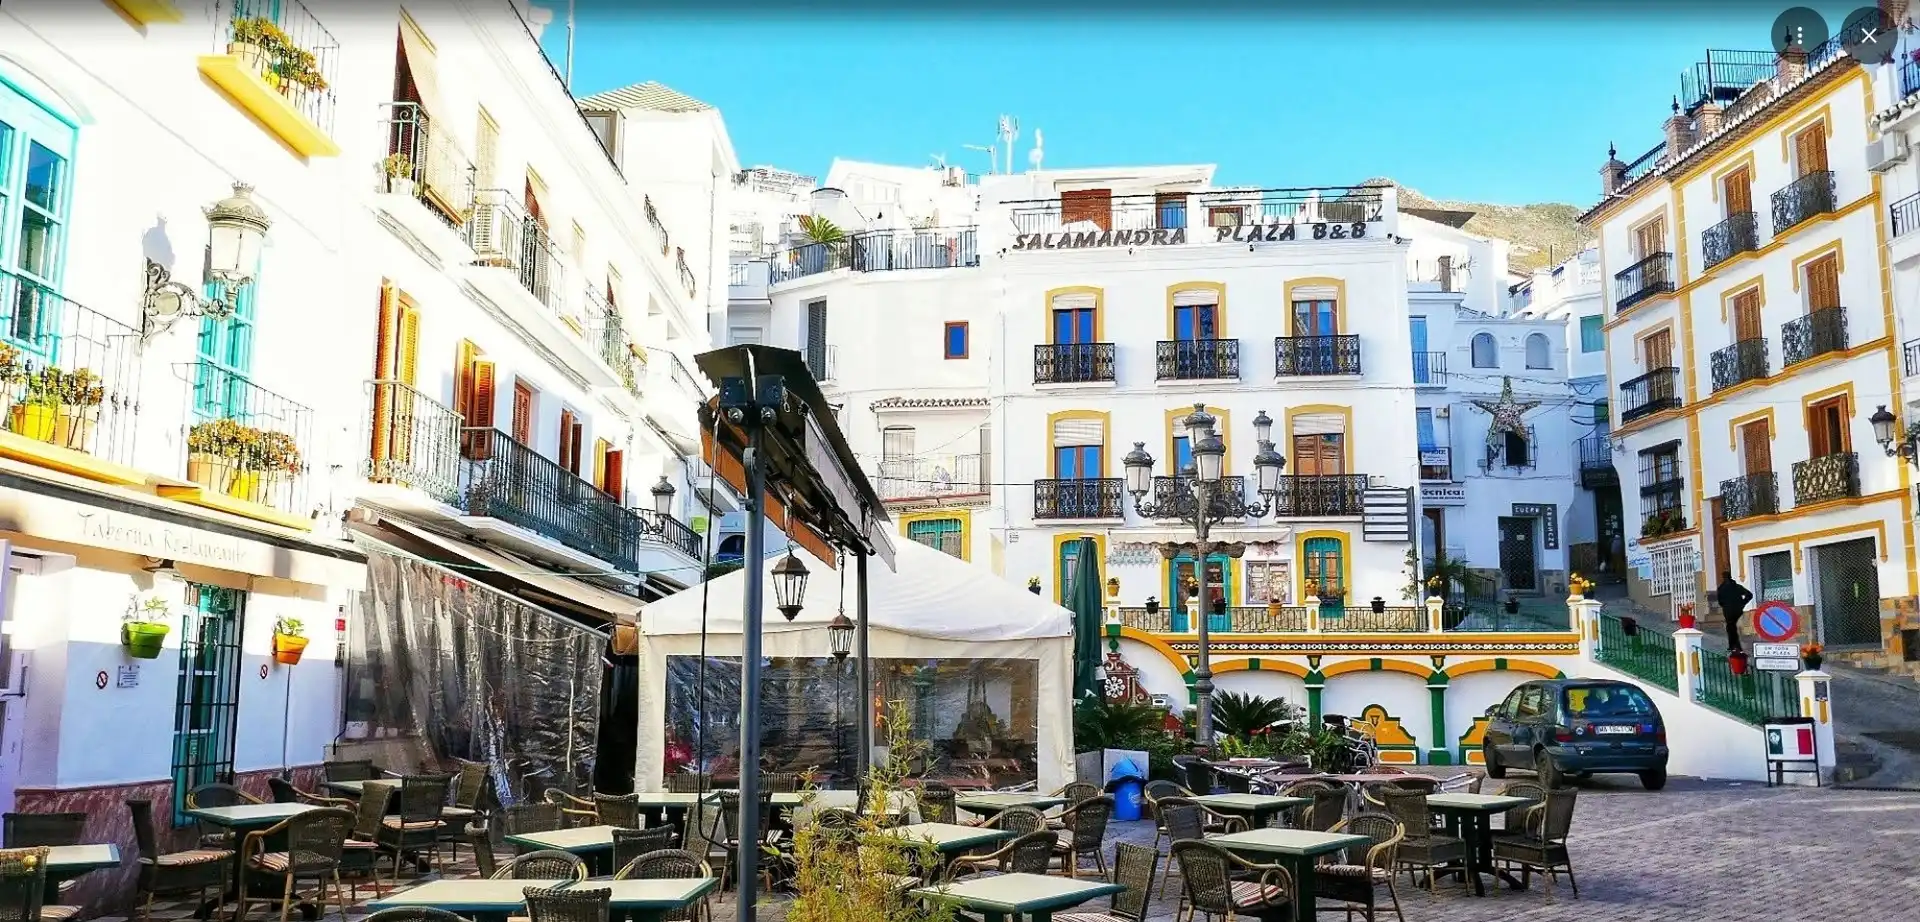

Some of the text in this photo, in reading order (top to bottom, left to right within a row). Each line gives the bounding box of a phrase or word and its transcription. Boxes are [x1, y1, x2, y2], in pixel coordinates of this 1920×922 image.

[1012, 221, 1366, 250] SALAMANDRA PLAZA B&B
[77, 510, 154, 548] Taberna
